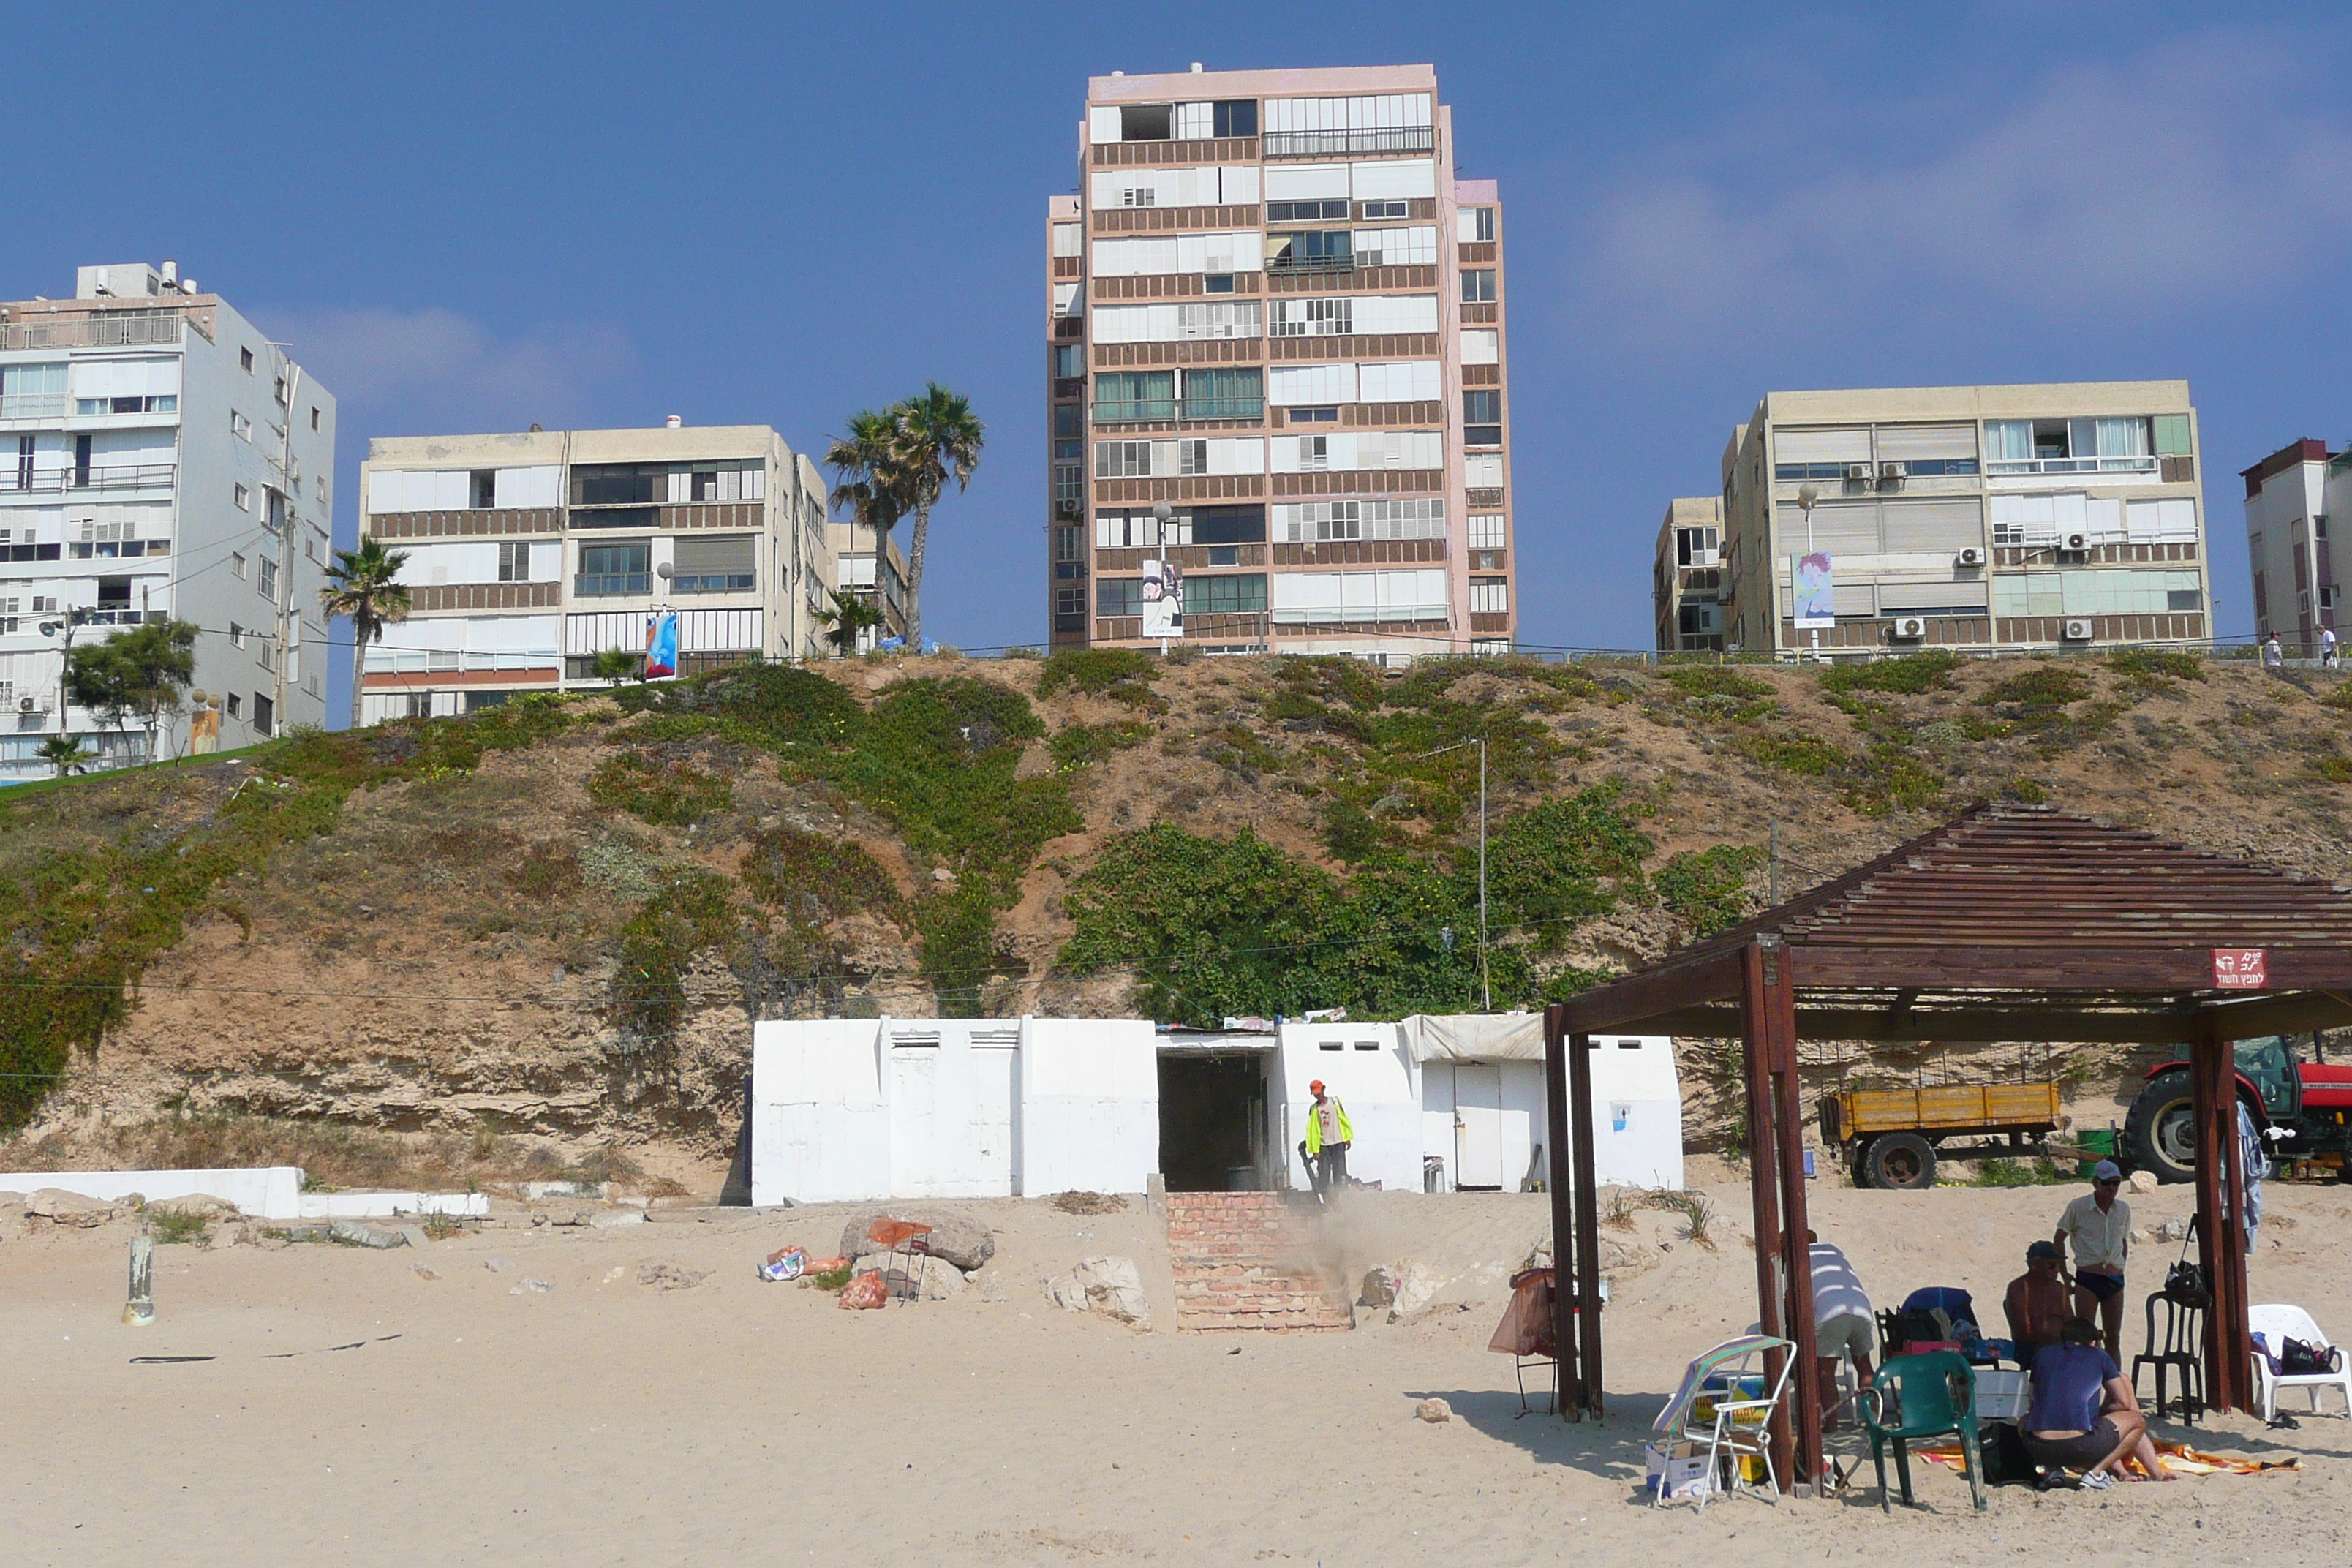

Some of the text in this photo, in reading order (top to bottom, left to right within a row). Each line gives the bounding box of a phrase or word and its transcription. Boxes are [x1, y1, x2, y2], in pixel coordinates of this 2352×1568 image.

[2241, 952, 2261, 961] שים
[2240, 961, 2258, 971] לב
[2217, 973, 2264, 986] לחפץ חשוד
